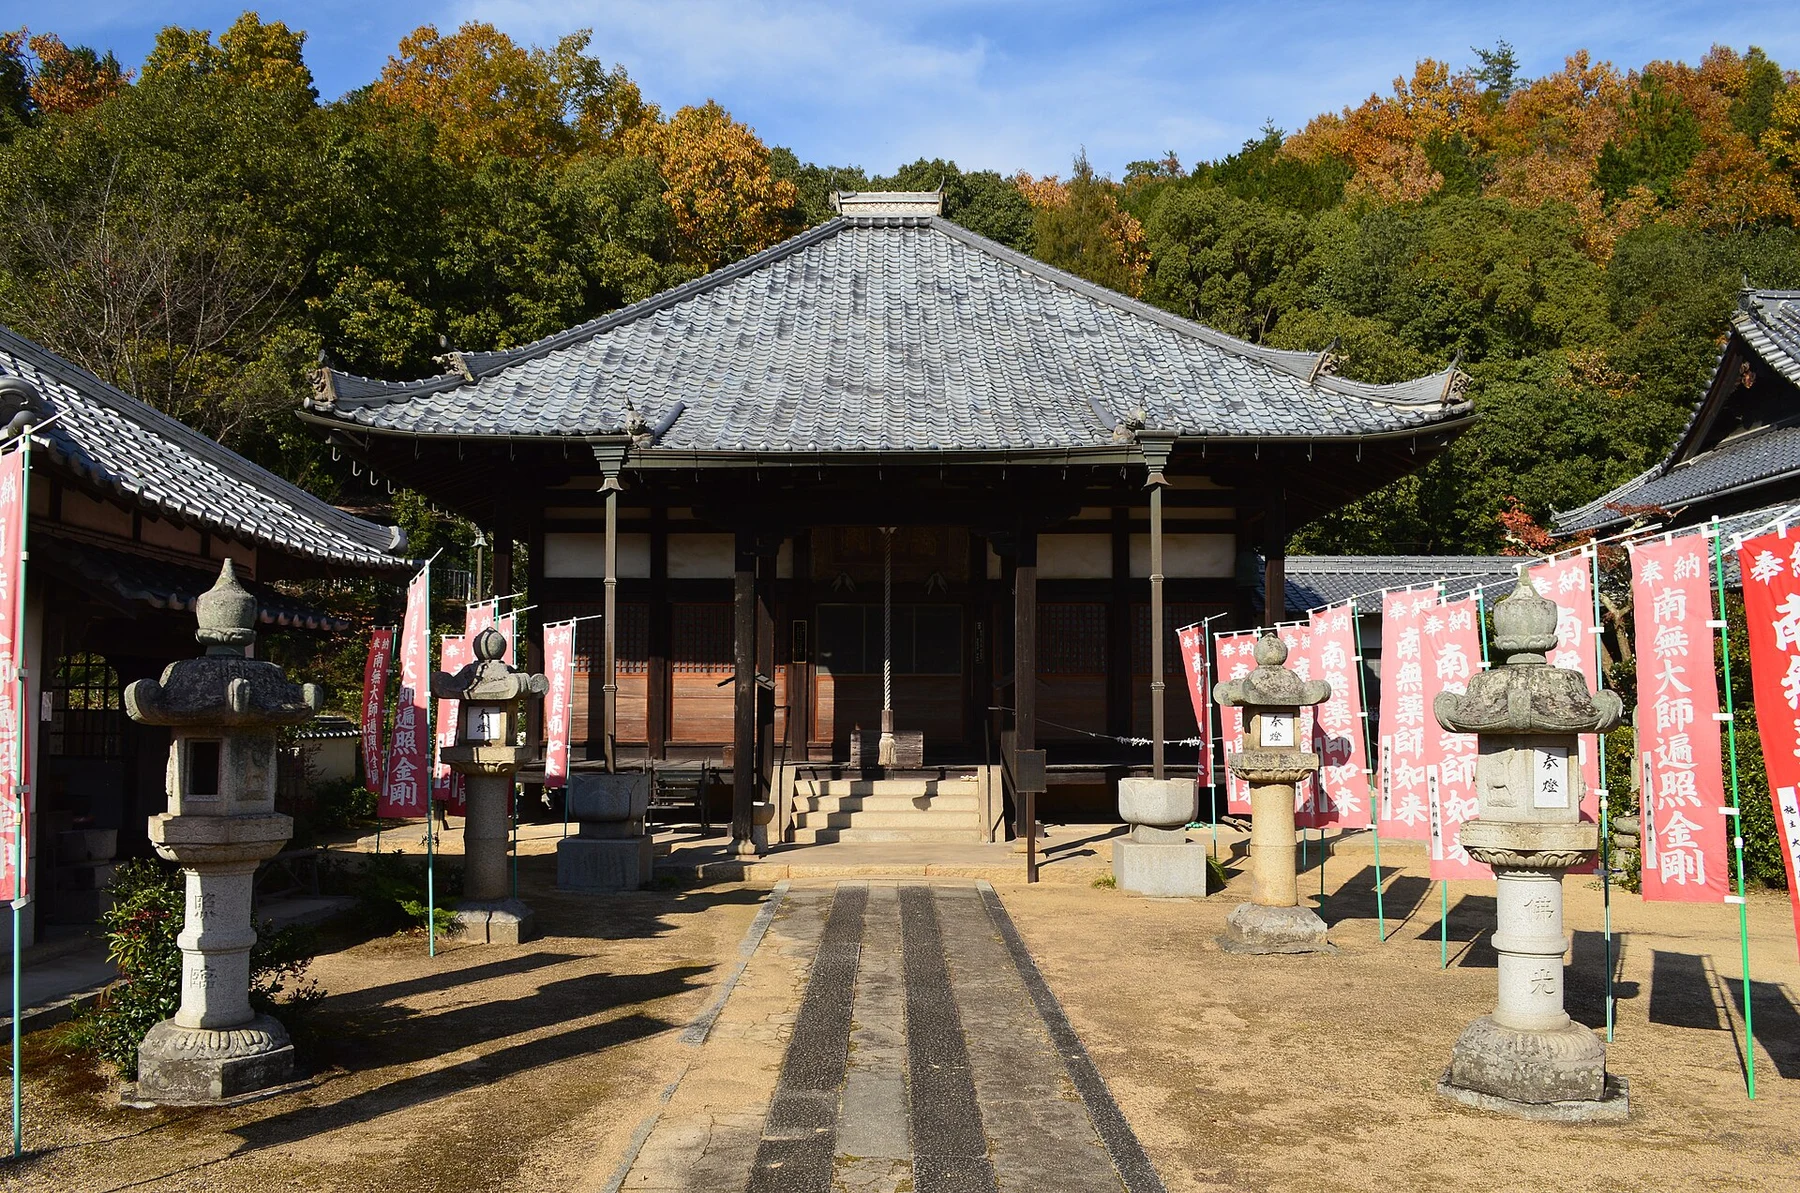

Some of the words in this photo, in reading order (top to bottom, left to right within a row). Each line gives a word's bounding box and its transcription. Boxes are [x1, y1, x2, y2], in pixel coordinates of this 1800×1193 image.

[1639, 552, 1701, 587] 奉納
[1314, 613, 1349, 637] 奉納
[1423, 608, 1472, 637] 奉納
[1320, 640, 1362, 817] 南無薬師如来
[1392, 626, 1428, 827] 南無薬師如来
[1652, 587, 1705, 885] 南無大師遍照金剛
[1541, 753, 1558, 794] 奉燈
